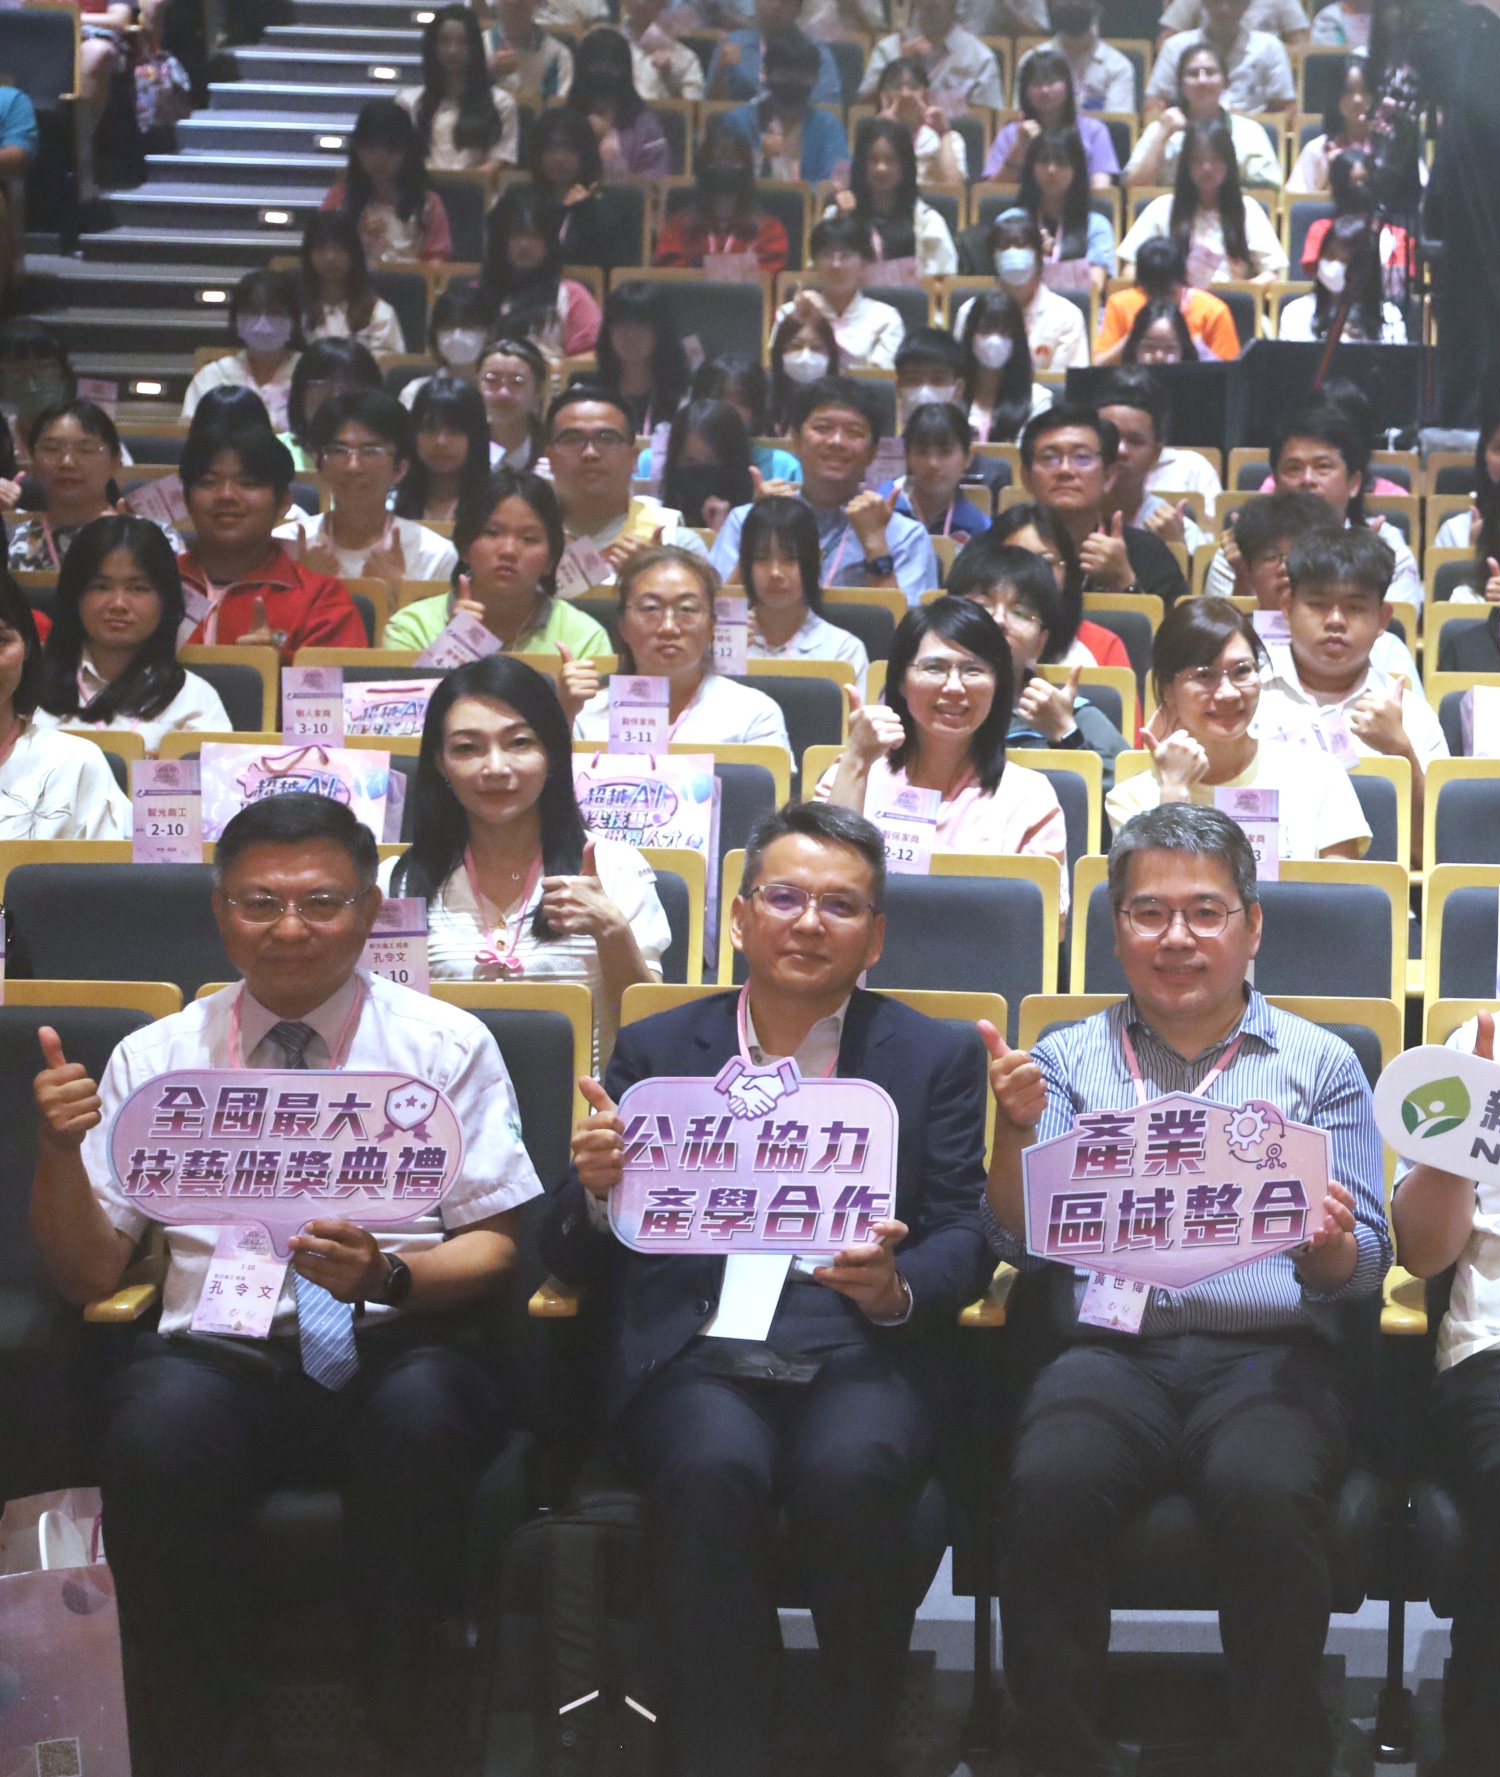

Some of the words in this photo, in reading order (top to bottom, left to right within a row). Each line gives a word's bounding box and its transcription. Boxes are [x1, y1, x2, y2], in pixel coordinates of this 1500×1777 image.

[299, 723, 328, 734] 3-10
[624, 731, 652, 743] 3-11
[585, 783, 666, 813] 超越AI
[151, 823, 184, 836] 2-10
[580, 811, 648, 829] 尖技藝
[884, 846, 914, 862] 2-12
[373, 952, 406, 963] 孔令文
[149, 1086, 373, 1140] 全國最大
[1070, 1108, 1209, 1180] 產業
[123, 1146, 448, 1200] 技藝頒獎典禮
[636, 1184, 892, 1242] 產學合作
[1045, 1179, 1311, 1257] 區域整合
[209, 1280, 275, 1300] 孔令文
